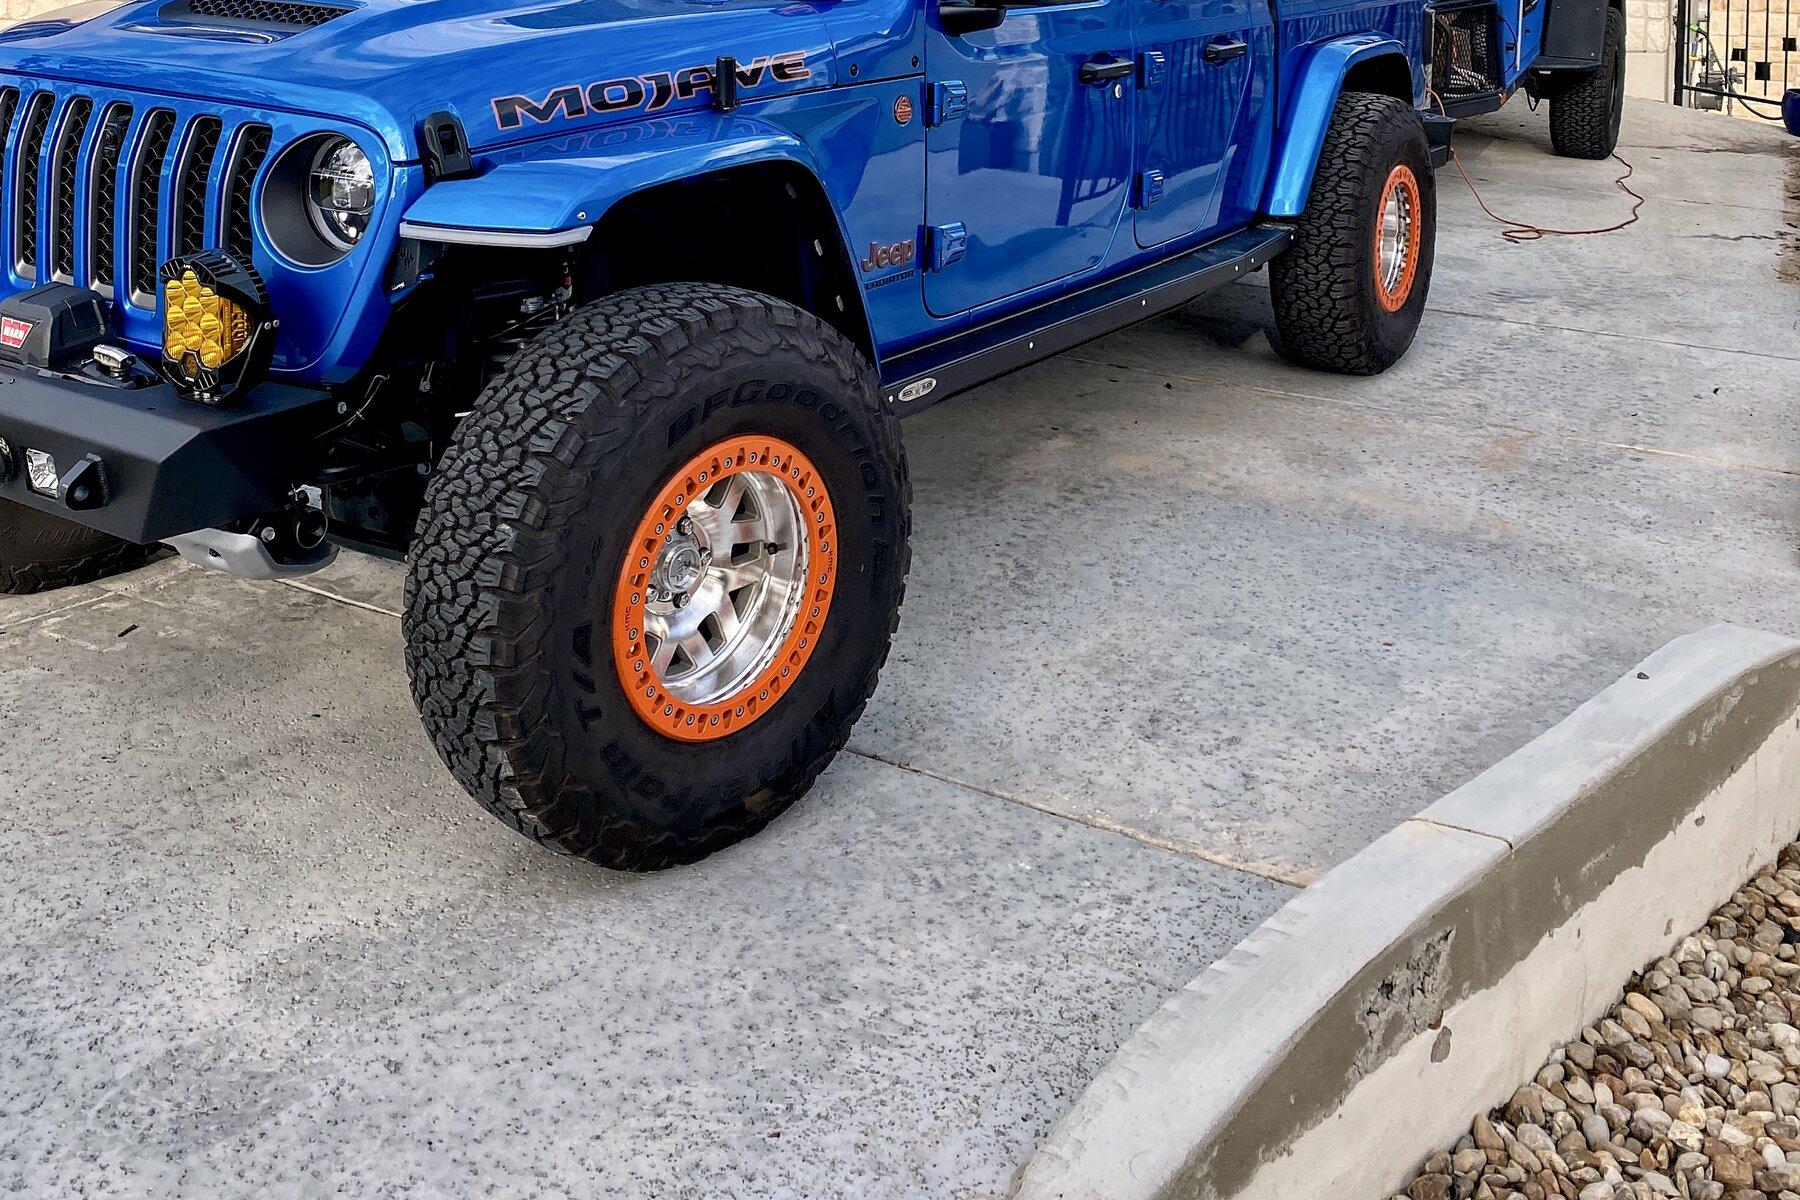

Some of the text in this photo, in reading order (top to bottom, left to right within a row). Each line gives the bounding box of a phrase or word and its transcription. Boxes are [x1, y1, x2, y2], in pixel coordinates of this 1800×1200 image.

[490, 50, 812, 131] MOJAVE
[860, 238, 914, 273] Jeep
[864, 268, 915, 291] LADIATOR
[666, 378, 886, 524] BFGoodrich
